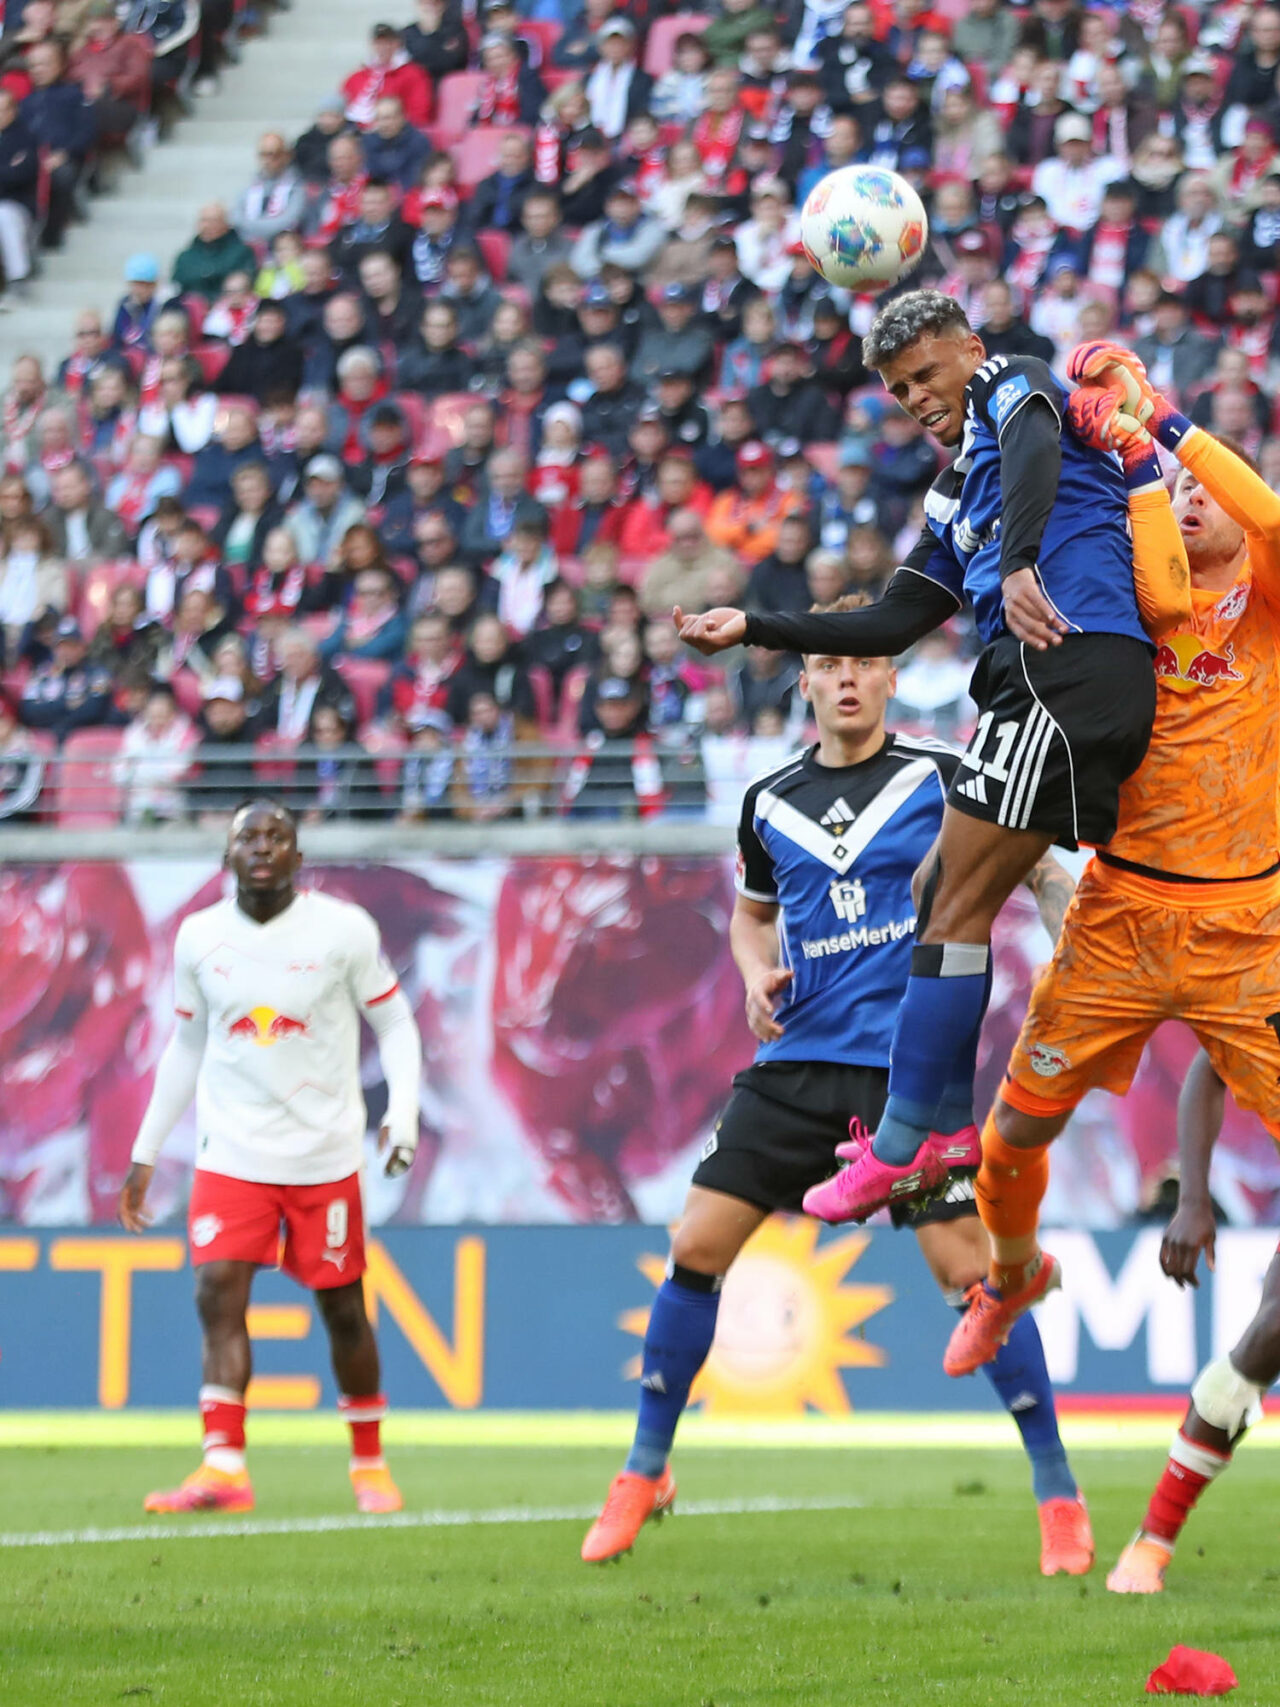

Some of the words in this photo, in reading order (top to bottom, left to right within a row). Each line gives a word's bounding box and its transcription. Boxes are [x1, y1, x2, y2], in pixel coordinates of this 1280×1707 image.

[1169, 426, 1181, 437] 1
[1153, 464, 1161, 477] 1
[961, 710, 1020, 783] 11
[326, 1198, 349, 1248] 9
[0, 1236, 485, 1410] TN
